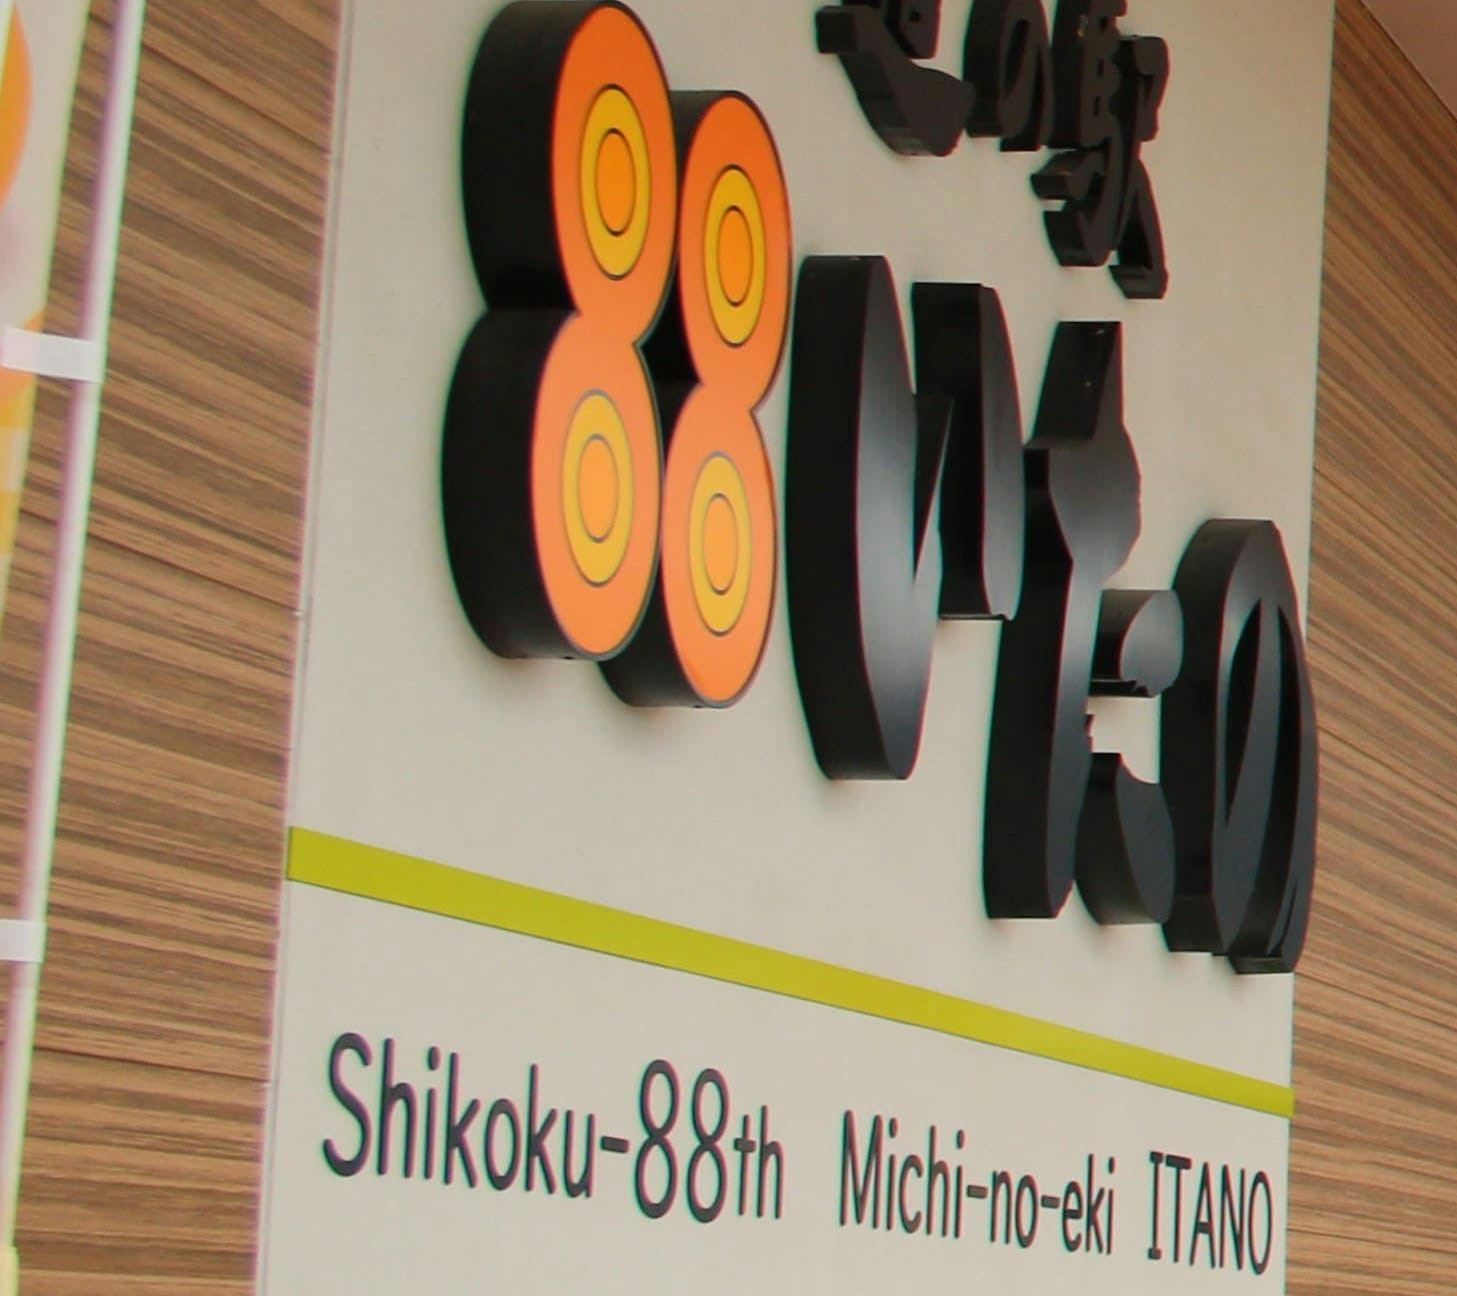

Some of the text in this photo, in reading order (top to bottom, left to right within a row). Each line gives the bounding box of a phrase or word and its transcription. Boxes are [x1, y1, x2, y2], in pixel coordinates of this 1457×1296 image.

[442, 0, 794, 708] 88
[320, 1032, 1275, 1277] Shikoku-88th Michi-no-eki ITANO
